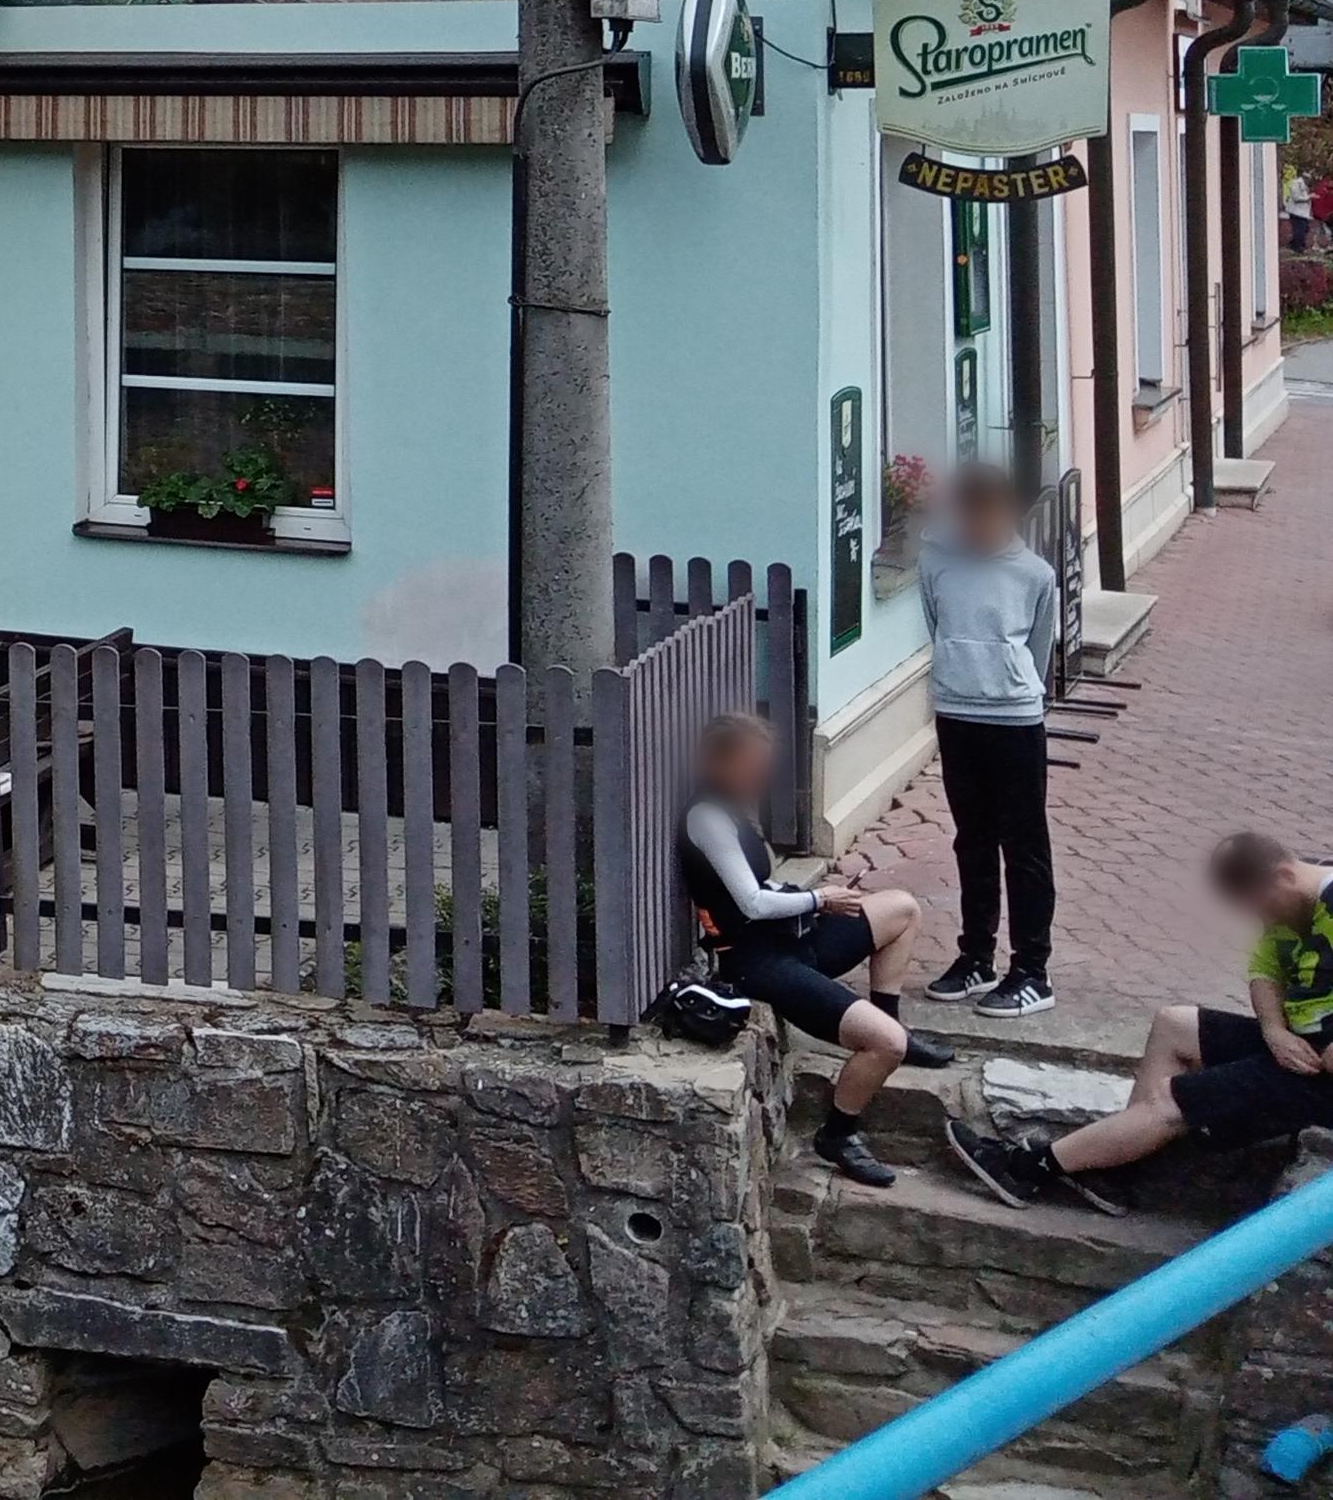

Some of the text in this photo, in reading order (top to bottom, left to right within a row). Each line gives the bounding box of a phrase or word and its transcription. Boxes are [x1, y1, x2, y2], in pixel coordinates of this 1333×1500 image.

[890, 15, 1097, 98] Staropramen
[937, 86, 992, 106] ZALOŽENO
[994, 82, 1009, 92] NA
[916, 162, 1070, 198] NEPASTER
